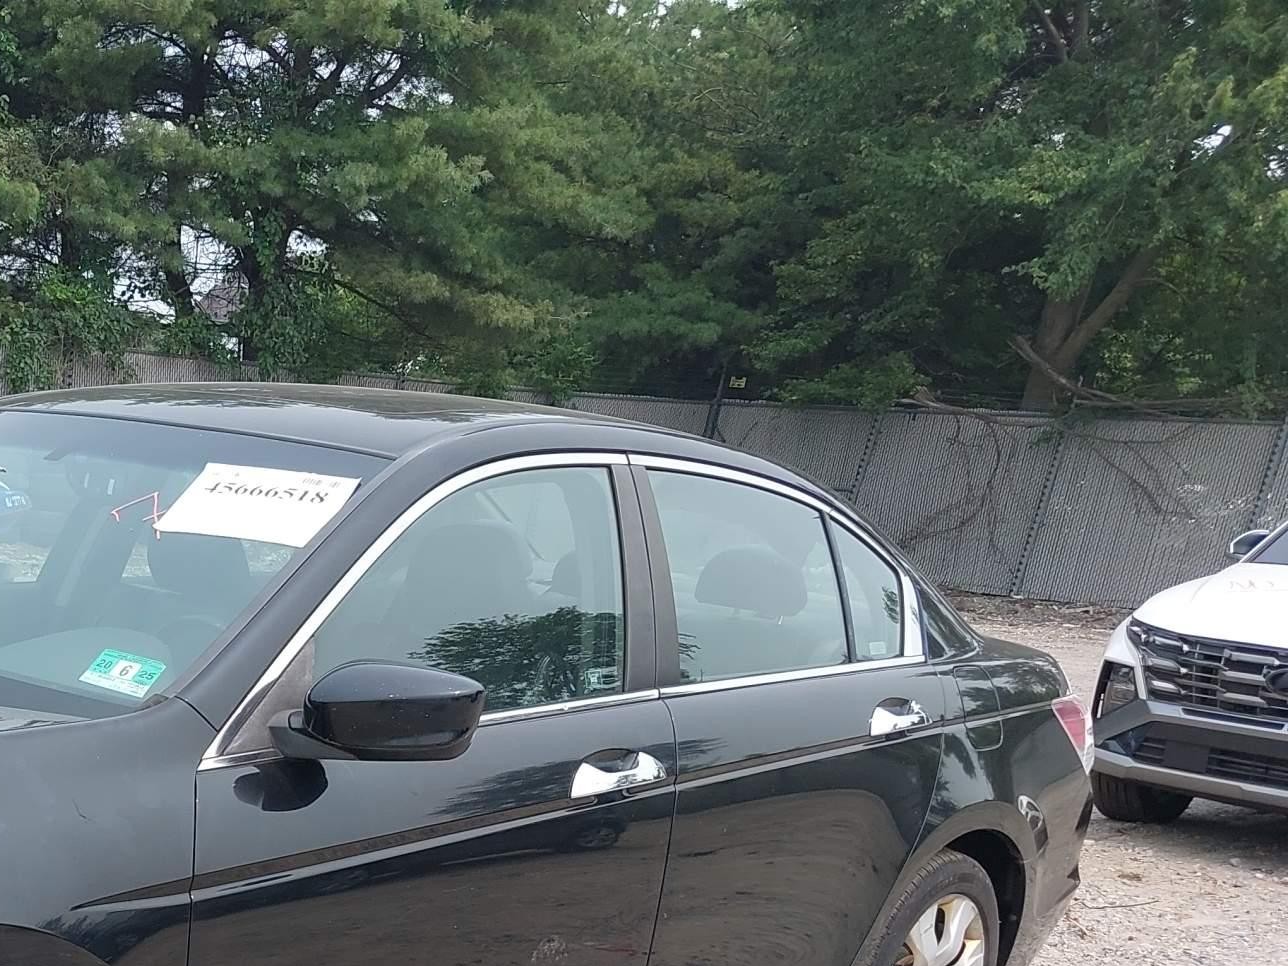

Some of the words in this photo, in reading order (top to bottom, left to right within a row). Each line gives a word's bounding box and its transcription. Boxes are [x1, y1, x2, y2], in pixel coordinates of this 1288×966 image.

[204, 481, 329, 504] 45666518
[95, 658, 113, 670] 20
[119, 664, 133, 677] 6
[137, 670, 157, 681] 25
